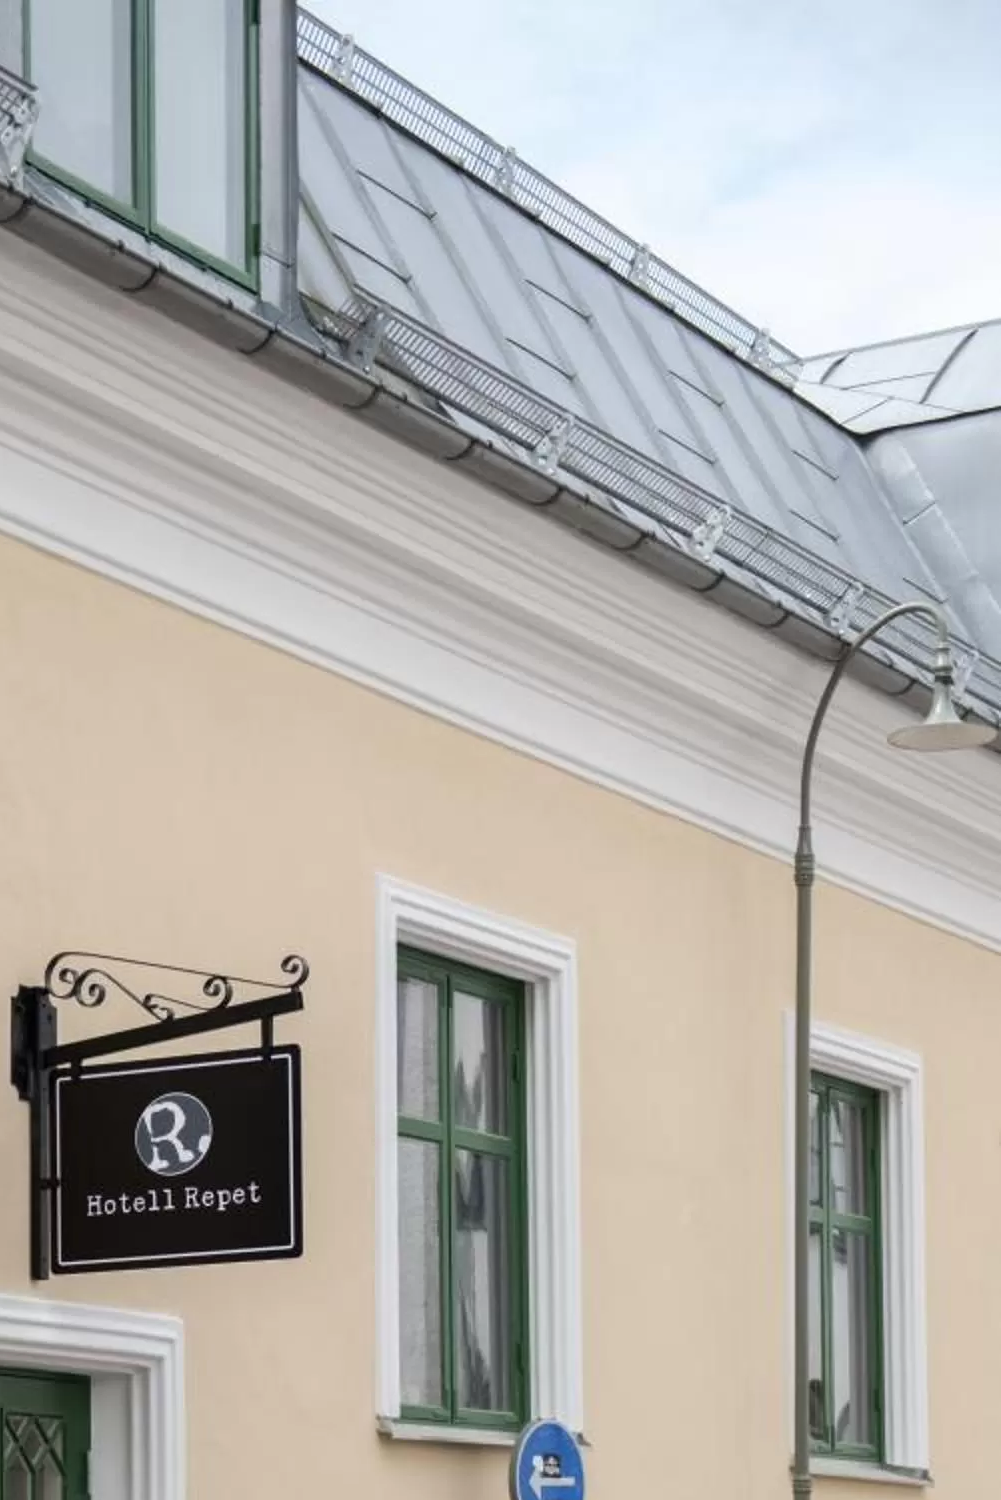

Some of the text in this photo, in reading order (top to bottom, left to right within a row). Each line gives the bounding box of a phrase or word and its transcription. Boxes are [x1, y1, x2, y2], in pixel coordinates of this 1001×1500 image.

[144, 1101, 195, 1171] R
[86, 1180, 262, 1217] Hotell Repet
